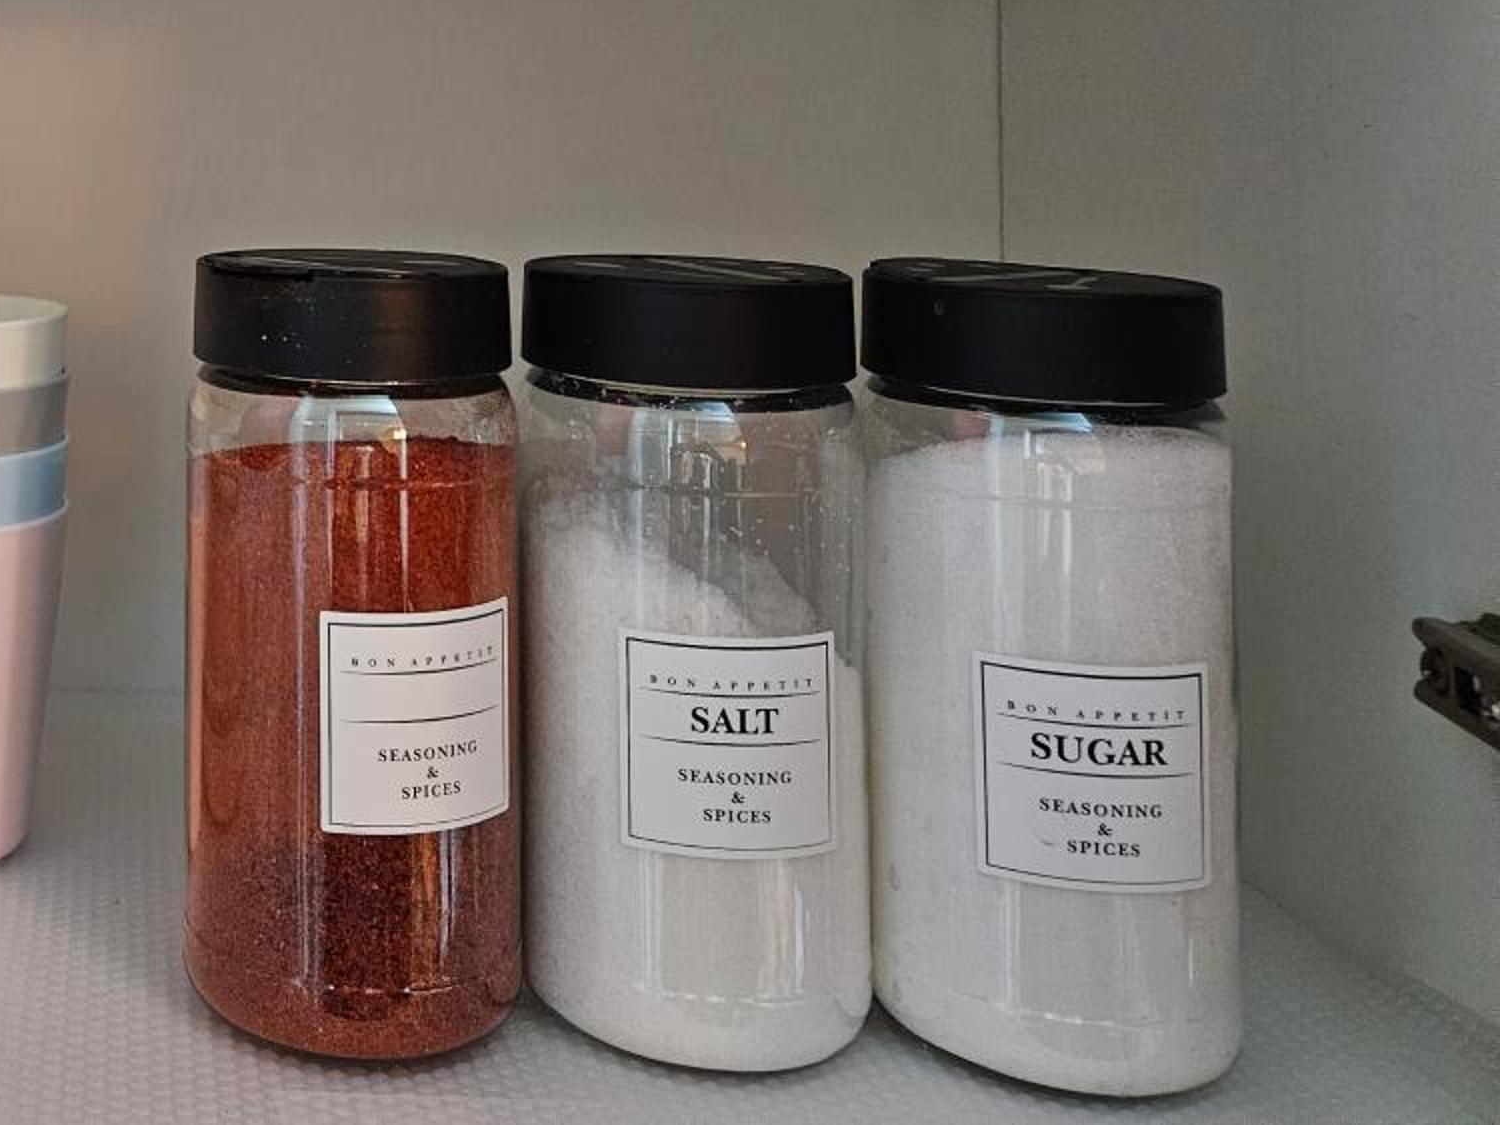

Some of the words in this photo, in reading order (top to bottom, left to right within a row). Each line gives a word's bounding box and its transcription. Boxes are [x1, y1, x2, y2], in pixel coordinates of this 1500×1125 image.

[351, 657, 395, 668] BON
[409, 646, 493, 667] APPETIT
[650, 674, 696, 688] BON
[712, 678, 813, 691] APPETIT
[1007, 700, 1057, 716] BON
[1076, 709, 1186, 722] APPETIT
[691, 706, 779, 735] SALT
[378, 739, 478, 762] SEASONING
[1030, 732, 1168, 766] SUGAR
[427, 766, 439, 779] &
[678, 768, 792, 786] SEASONING
[401, 781, 462, 800] SPICES
[731, 791, 745, 804] &
[703, 808, 771, 824] SPICES
[1039, 797, 1163, 818] SEASONING
[1097, 823, 1113, 836] &
[1067, 840, 1141, 857] SPICES
